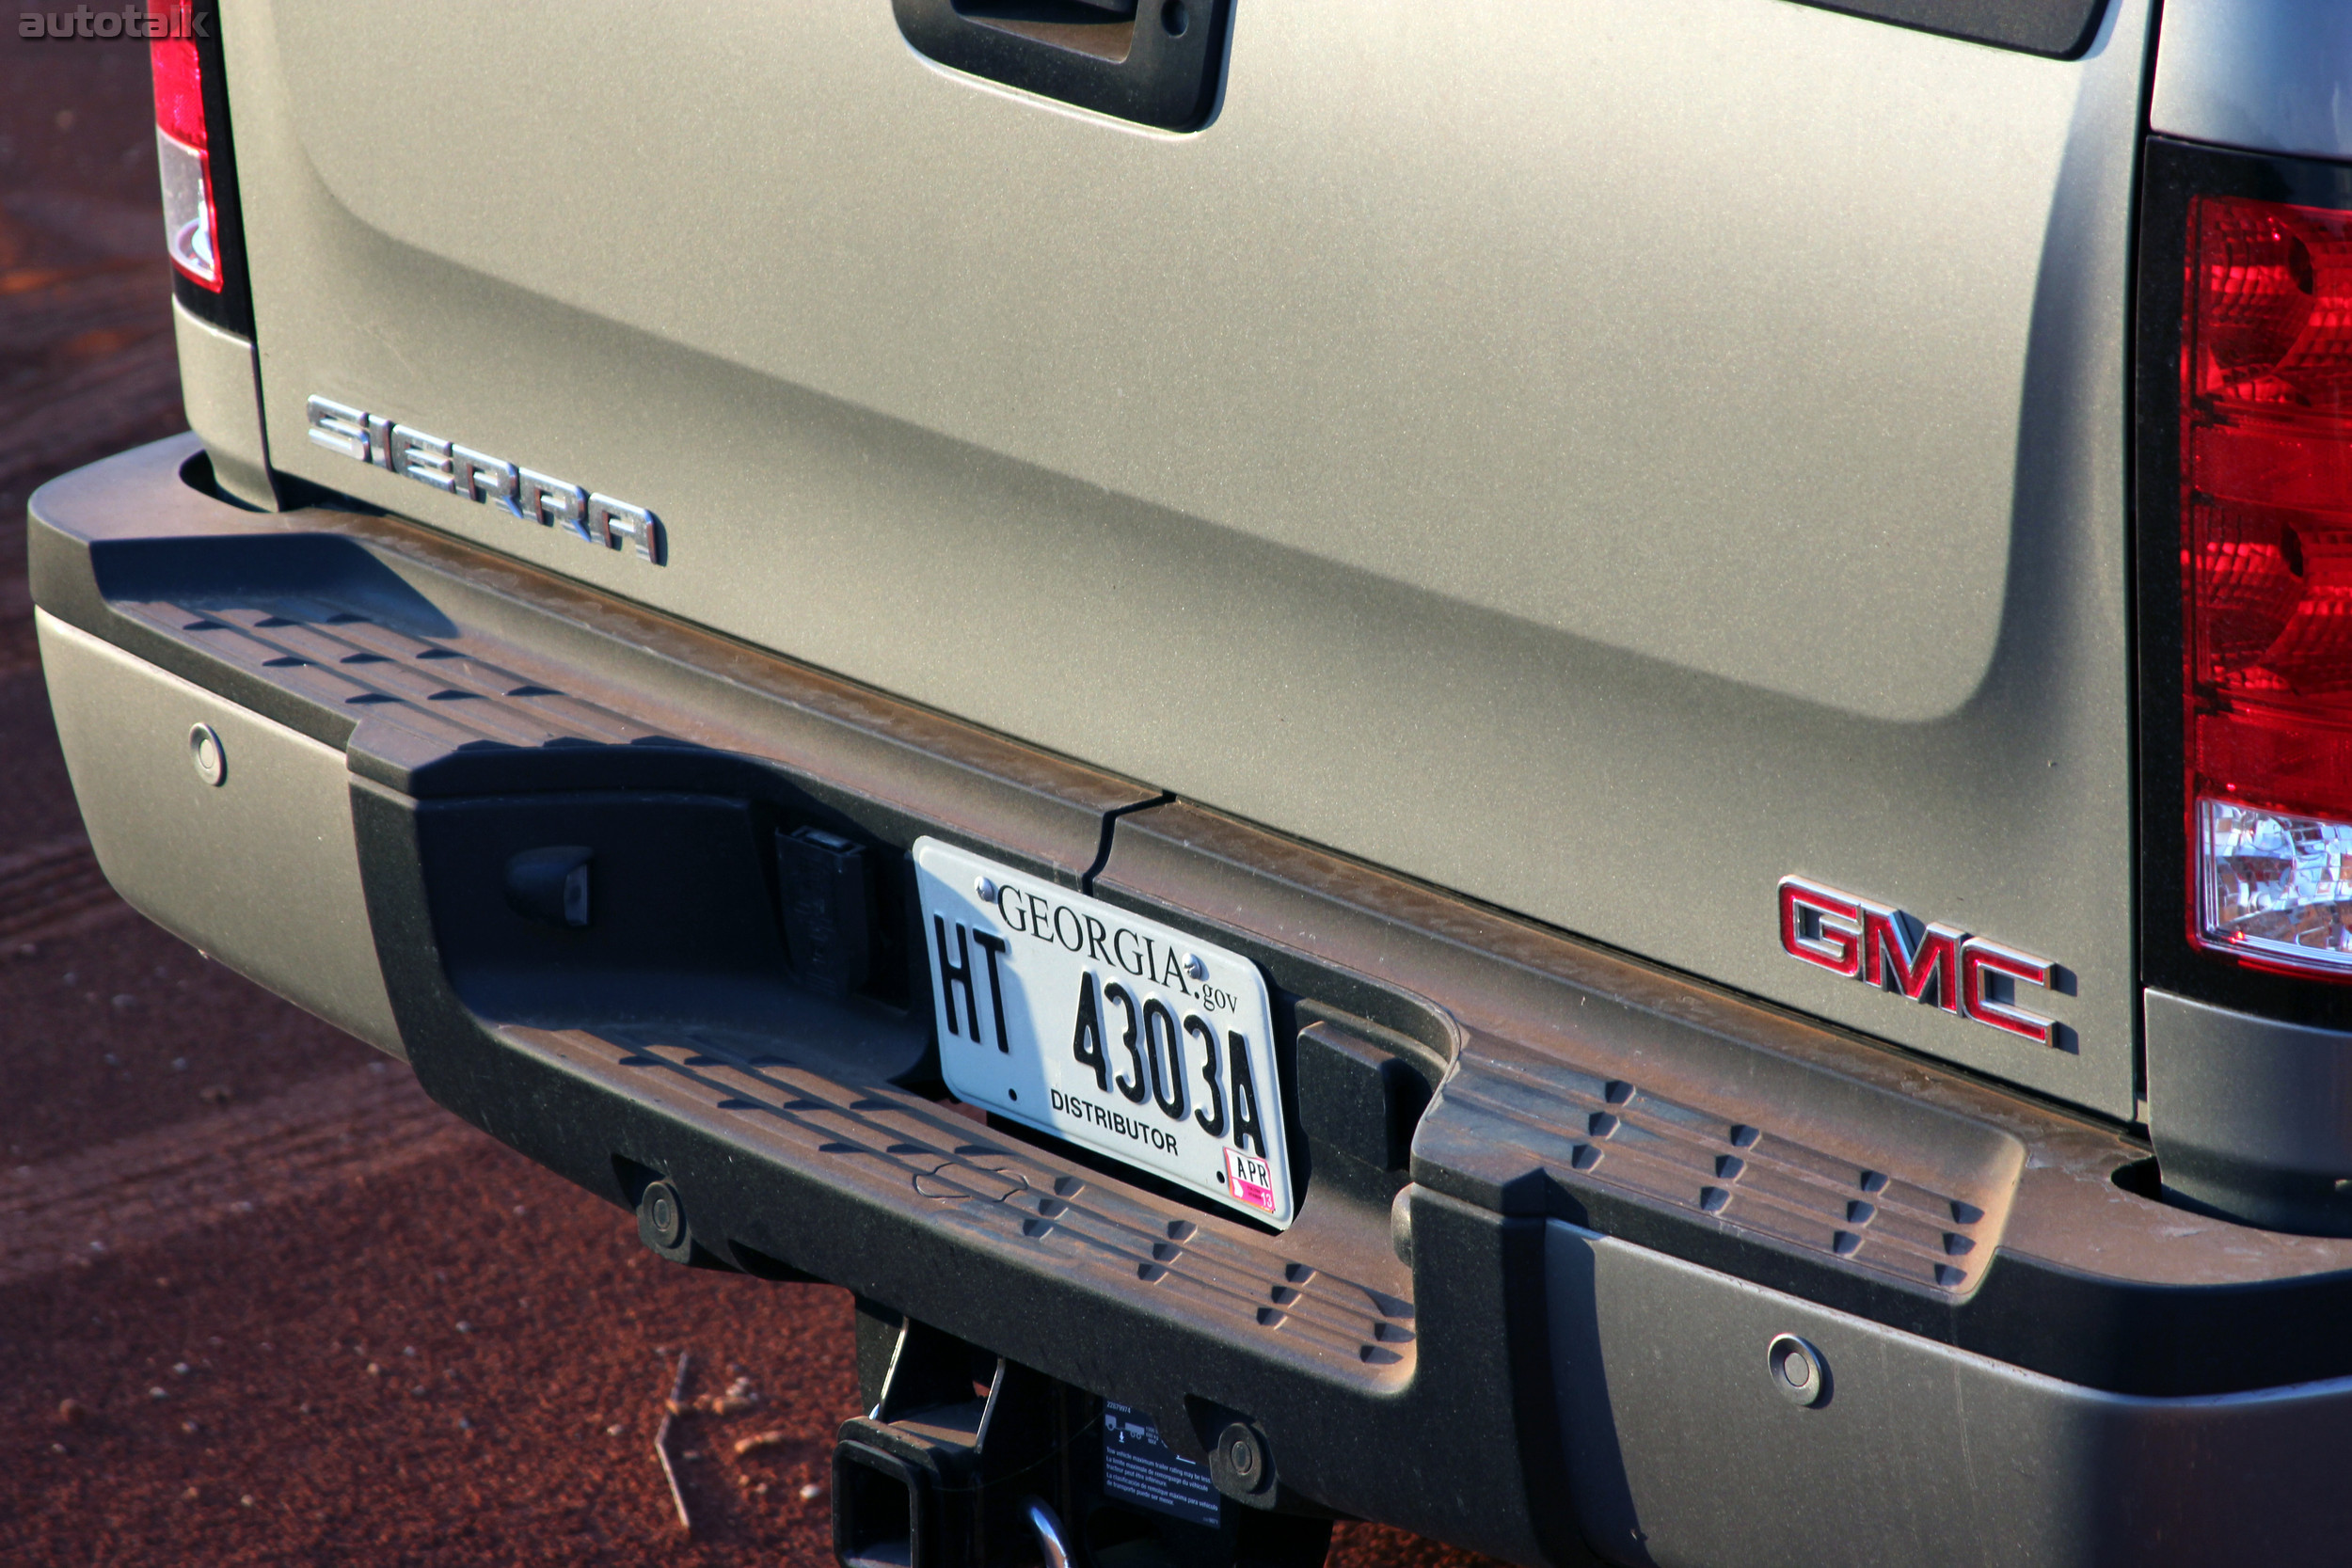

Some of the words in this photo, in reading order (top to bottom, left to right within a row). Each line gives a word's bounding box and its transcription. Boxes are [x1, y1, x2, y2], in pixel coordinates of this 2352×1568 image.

[308, 394, 660, 564] SIERRA
[1777, 874, 2058, 1047] GMC
[933, 913, 1007, 1054] HT
[1073, 971, 1266, 1159] 4303A
[1050, 1088, 1179, 1157] DISTRIBUTOR
[1237, 1157, 1269, 1188] APR
[1261, 1192, 1273, 1209] 13
[1117, 1449, 1132, 1460] vehicle
[1133, 1455, 1154, 1467] maximum
[1155, 1462, 1168, 1471] trailer
[1169, 1465, 1183, 1477] rating
[1184, 1470, 1193, 1480] may
[1124, 1468, 1135, 1478] peut
[1136, 1489, 1150, 1498] puede
[1188, 1497, 1198, 1507] para
